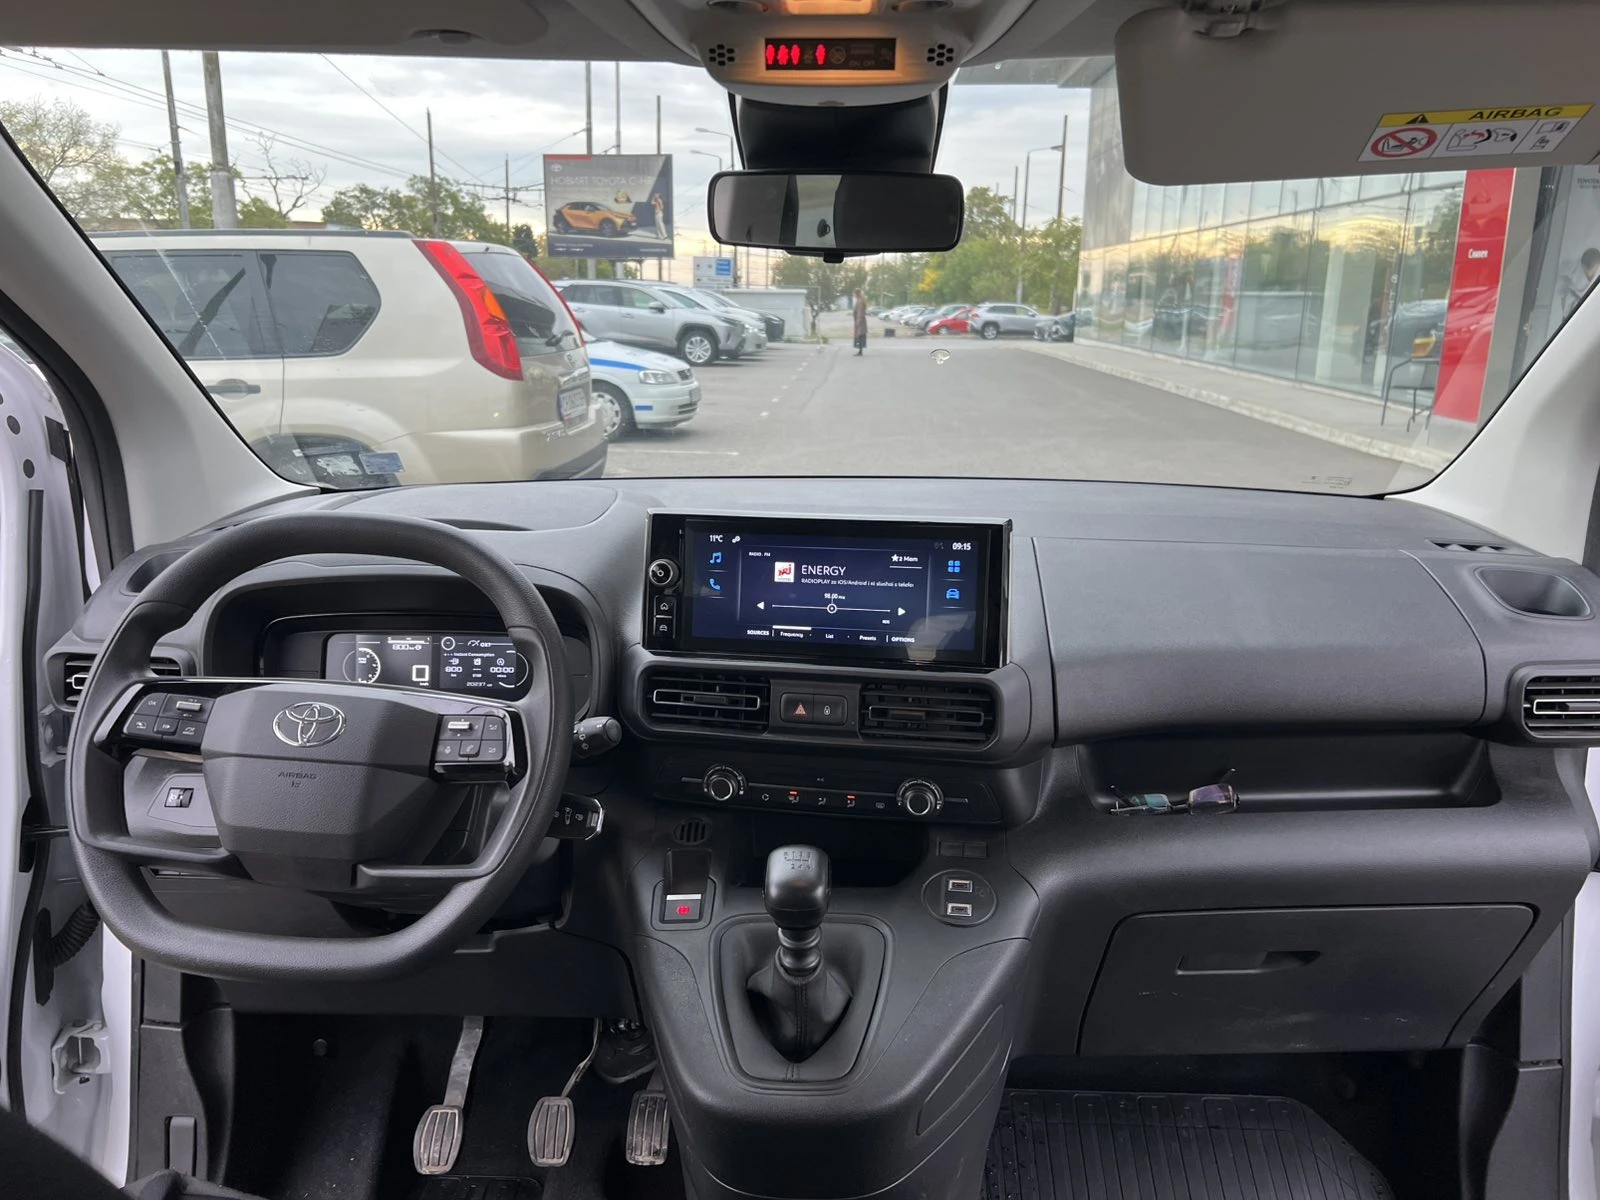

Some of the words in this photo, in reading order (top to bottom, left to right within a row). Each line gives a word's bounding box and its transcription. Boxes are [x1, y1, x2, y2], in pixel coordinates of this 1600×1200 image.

[1468, 107, 1564, 121] AIRBAG
[952, 542, 971, 551] 09:15
[801, 564, 847, 576] ENERGY
[780, 631, 804, 639] Frequency
